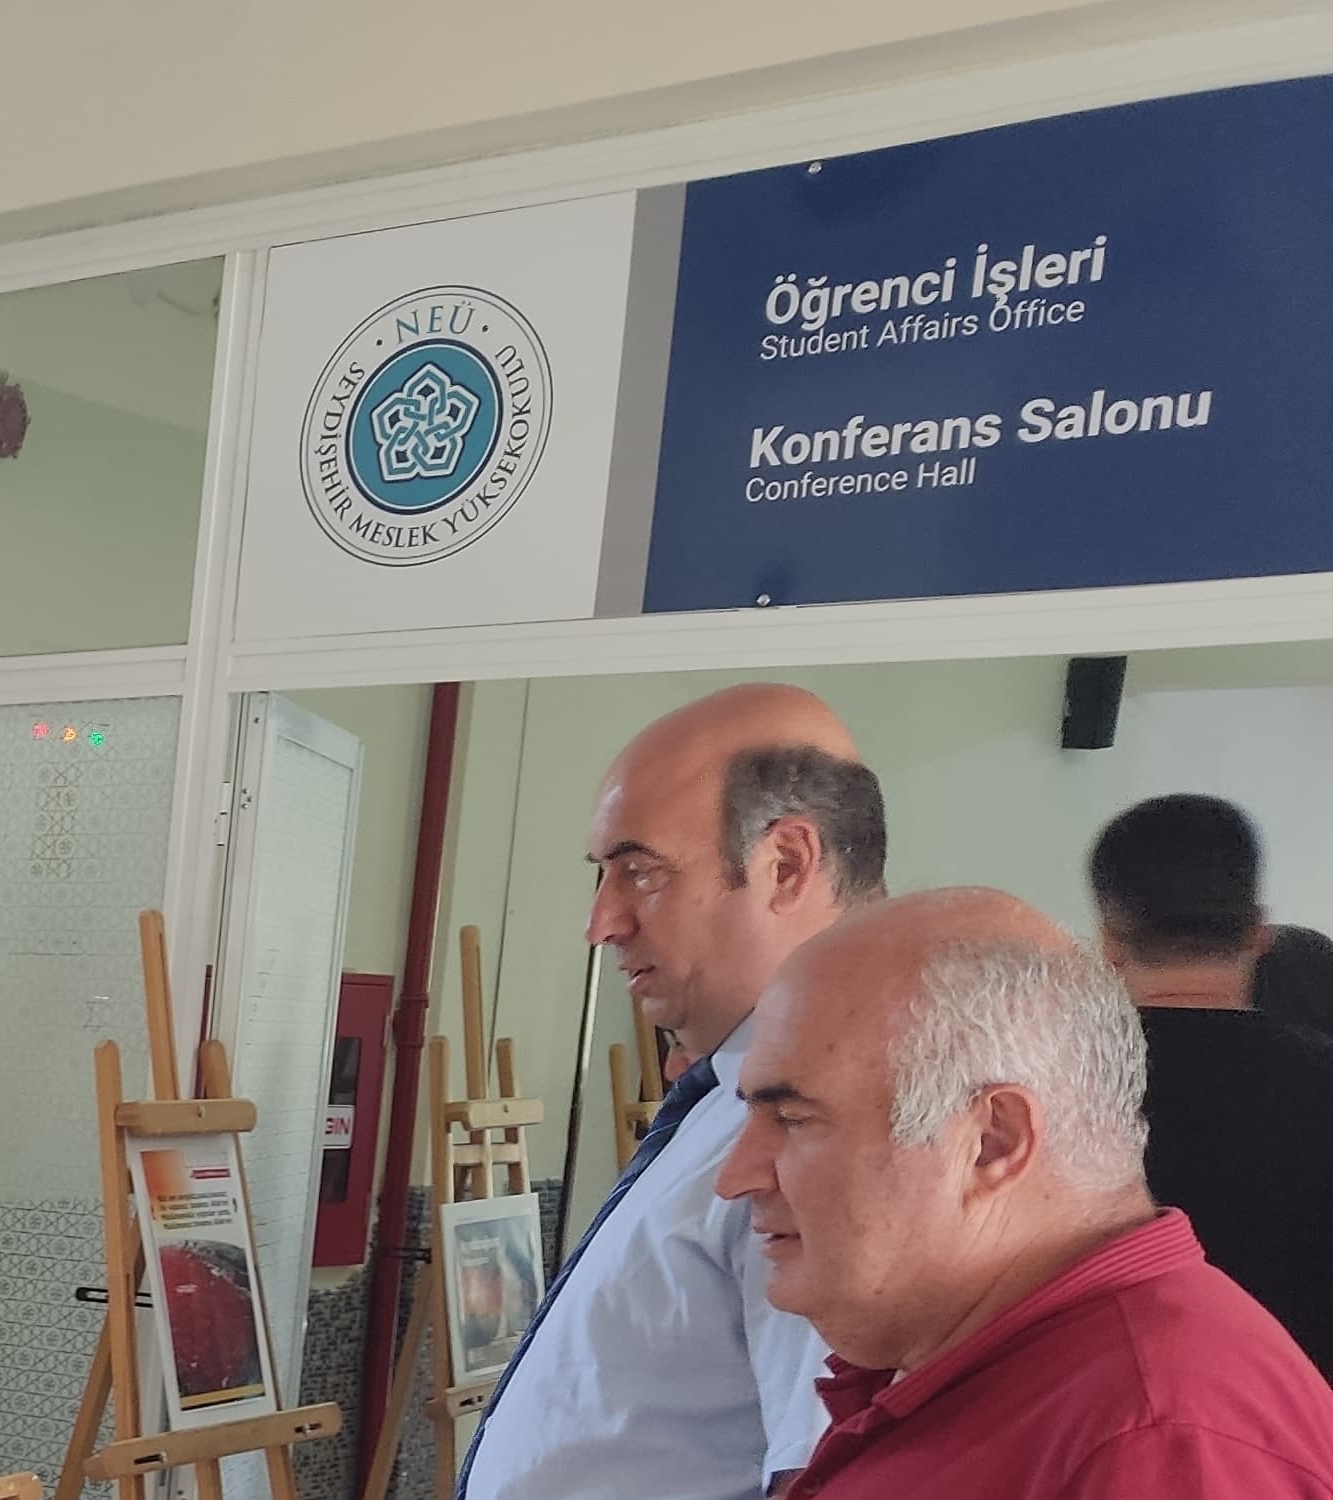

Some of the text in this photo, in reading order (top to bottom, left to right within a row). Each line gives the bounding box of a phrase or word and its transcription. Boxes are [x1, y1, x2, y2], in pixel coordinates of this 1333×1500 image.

[764, 235, 1108, 331] Öğrenci İşleri
[395, 301, 476, 345] NEÜ
[759, 299, 1086, 361] Student Affairs Office
[314, 344, 533, 549] SEYDİŞEHİR MESLEK YÜKSEKOKULU
[749, 389, 1213, 468] Konferans Salonu
[744, 456, 977, 502] Conference Hall
